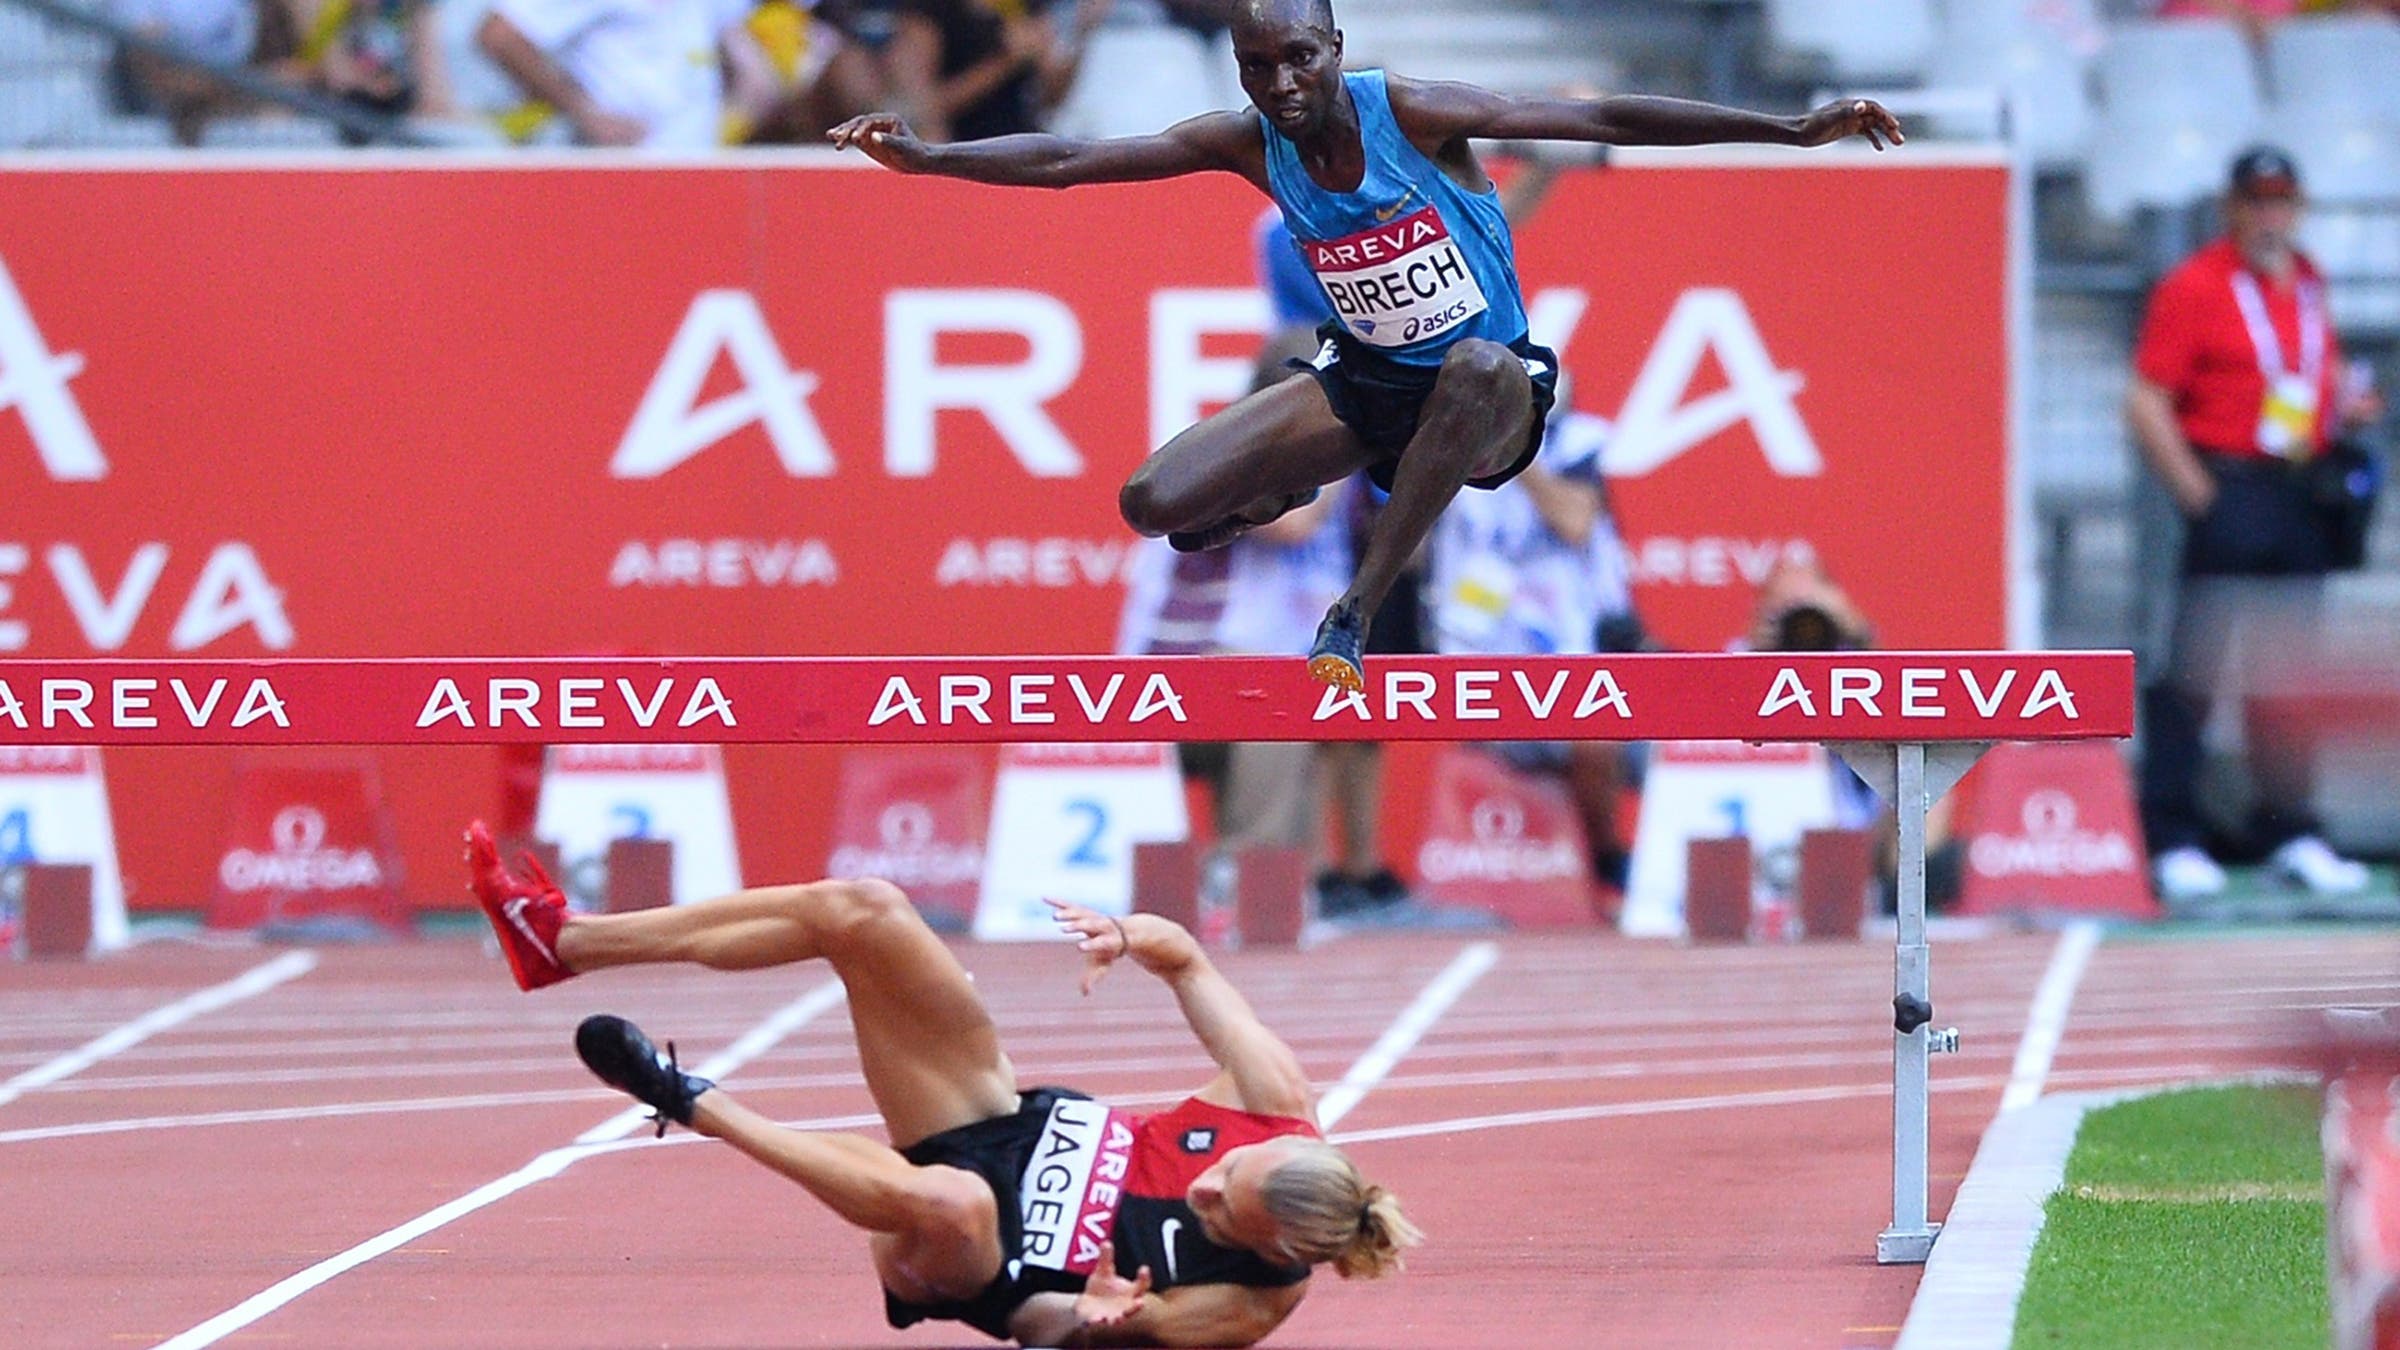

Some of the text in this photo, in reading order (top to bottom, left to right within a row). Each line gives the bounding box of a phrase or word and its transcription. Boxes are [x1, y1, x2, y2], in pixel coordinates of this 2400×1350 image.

[1317, 219, 1438, 266] AREVA
[1325, 246, 1465, 316] BIRECH
[1425, 300, 1468, 333] asics
[609, 538, 839, 587] AREVA
[416, 678, 736, 727] AREVA
[868, 674, 1187, 725] AREVA
[1313, 669, 1633, 720] AREVA
[1758, 668, 2078, 718] AREVA
[1064, 799, 1111, 869] 2
[1021, 1105, 1089, 1257] JAGER
[1073, 1120, 1135, 1264] AREVA
